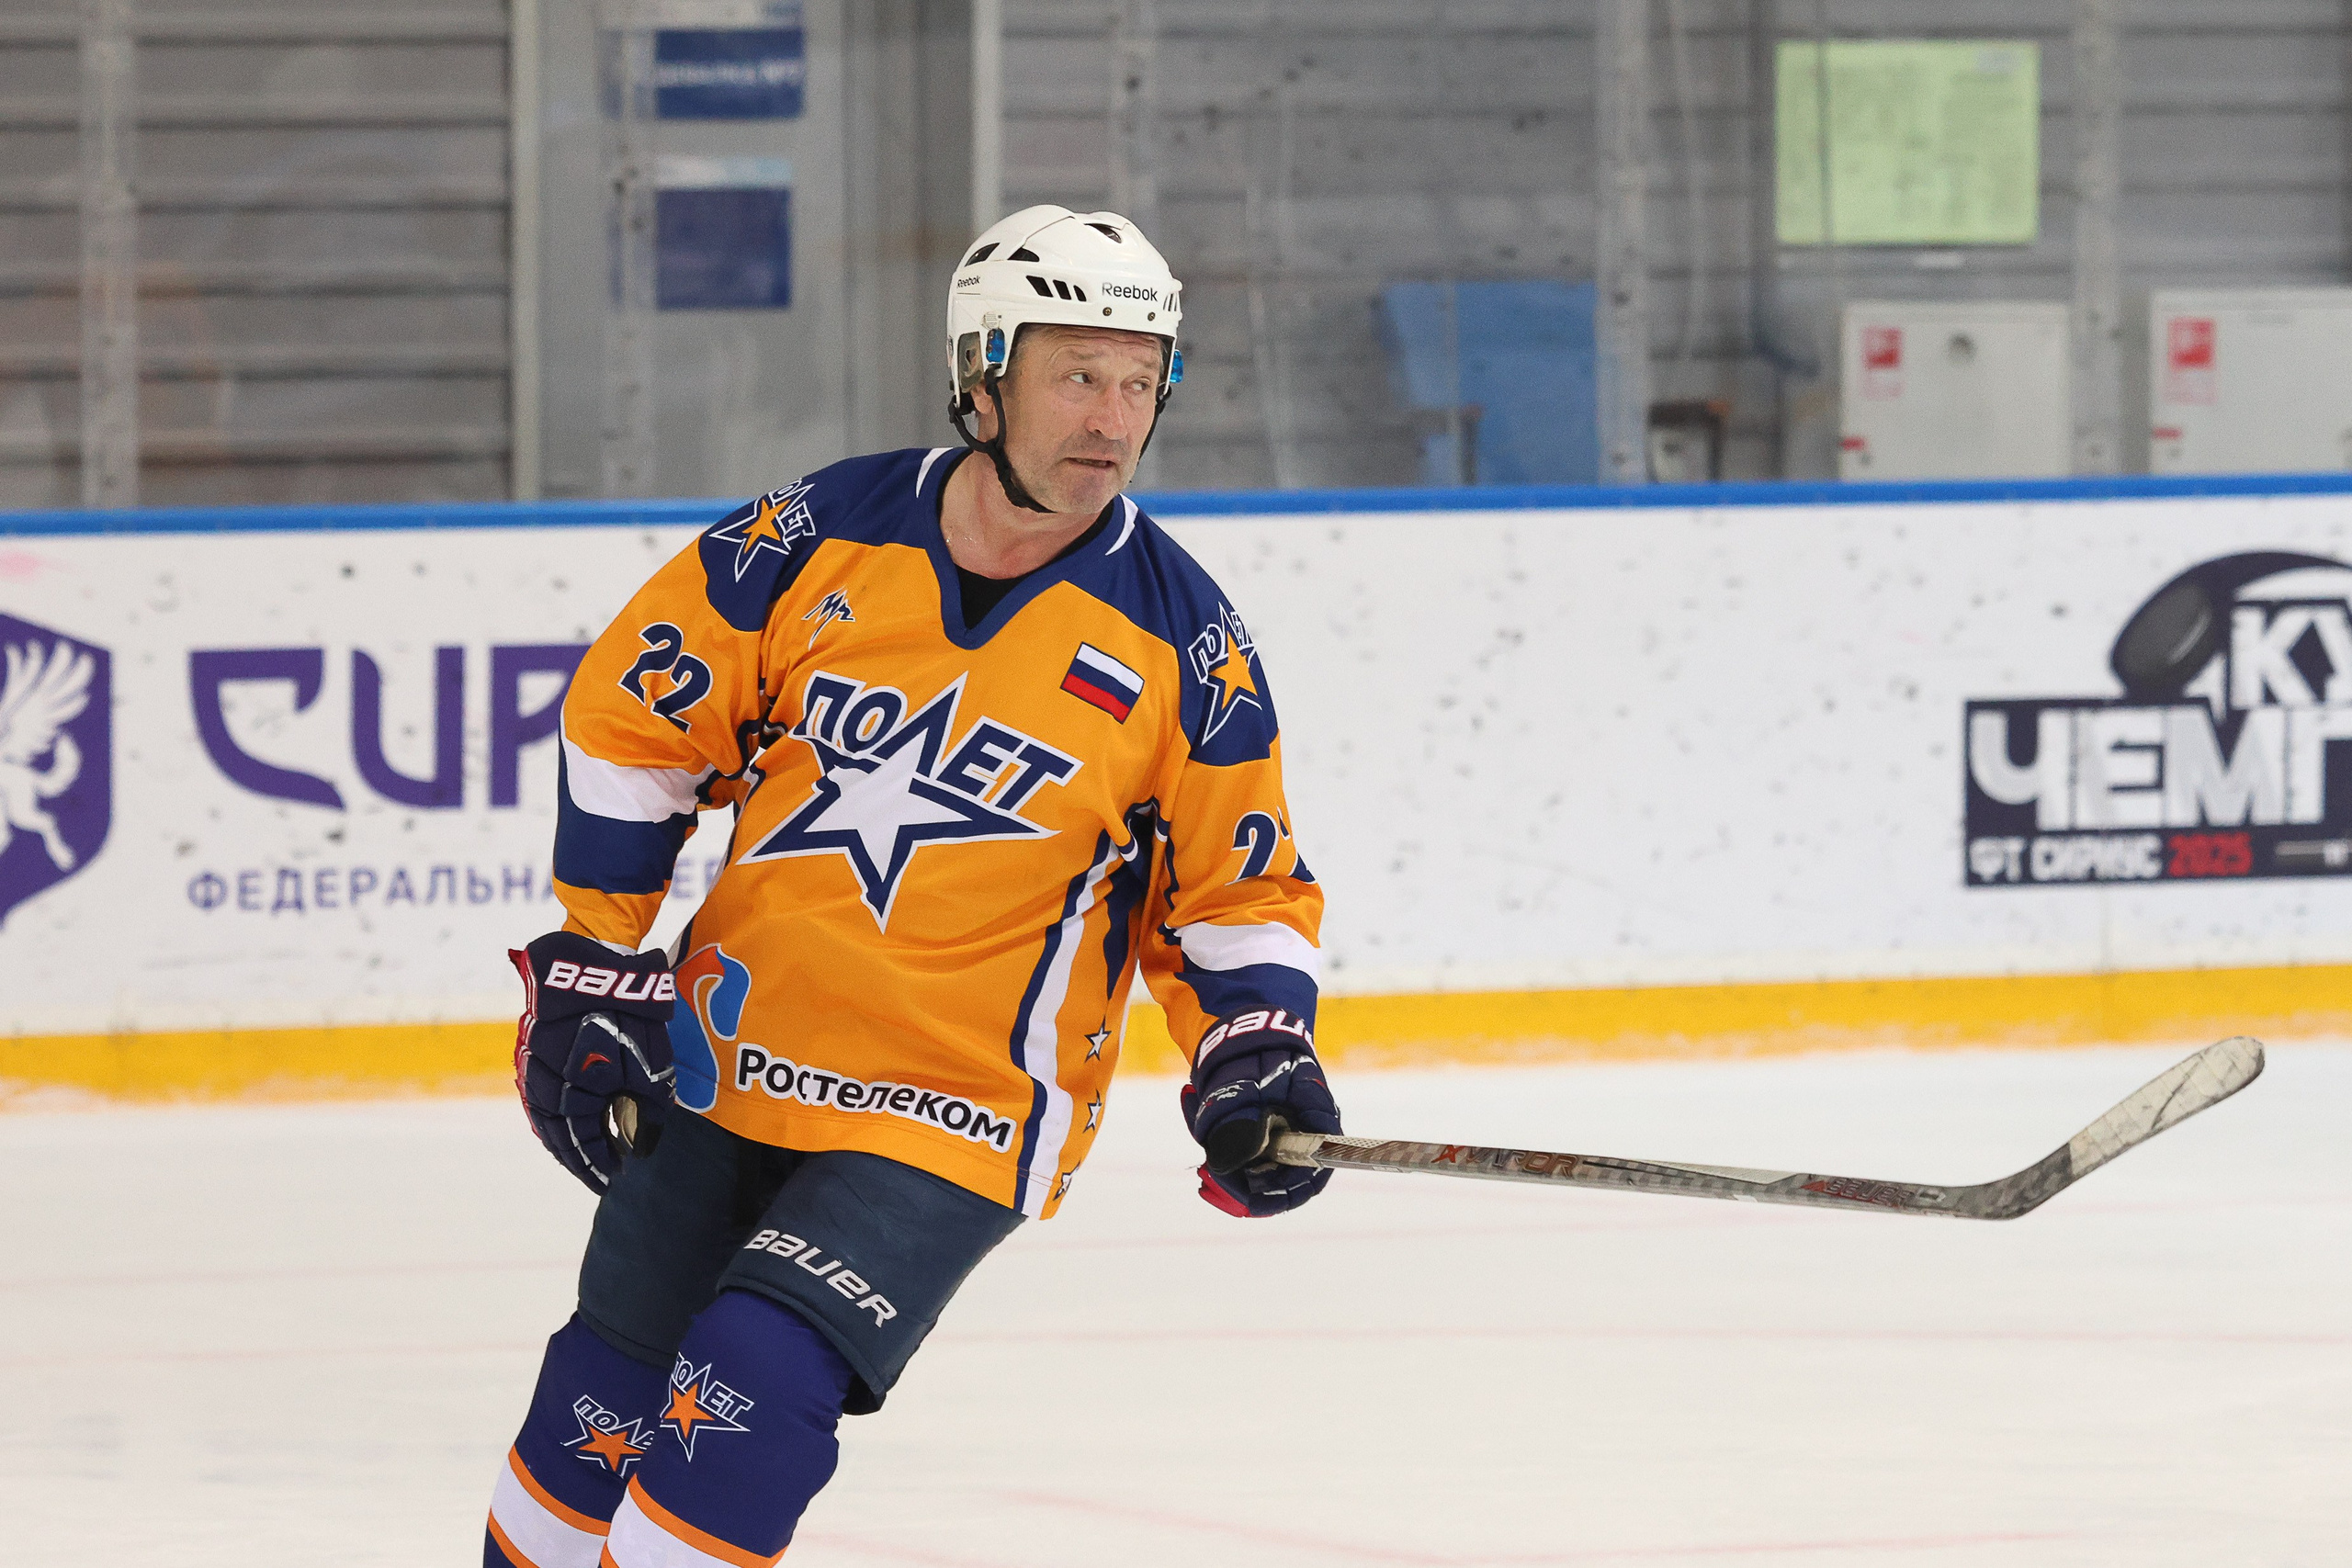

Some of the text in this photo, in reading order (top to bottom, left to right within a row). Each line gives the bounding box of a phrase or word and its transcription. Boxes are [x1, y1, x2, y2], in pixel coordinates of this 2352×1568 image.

[1102, 282, 1159, 302] Reebok
[616, 621, 714, 735] 22
[787, 670, 1085, 816] ПОЛЕТ
